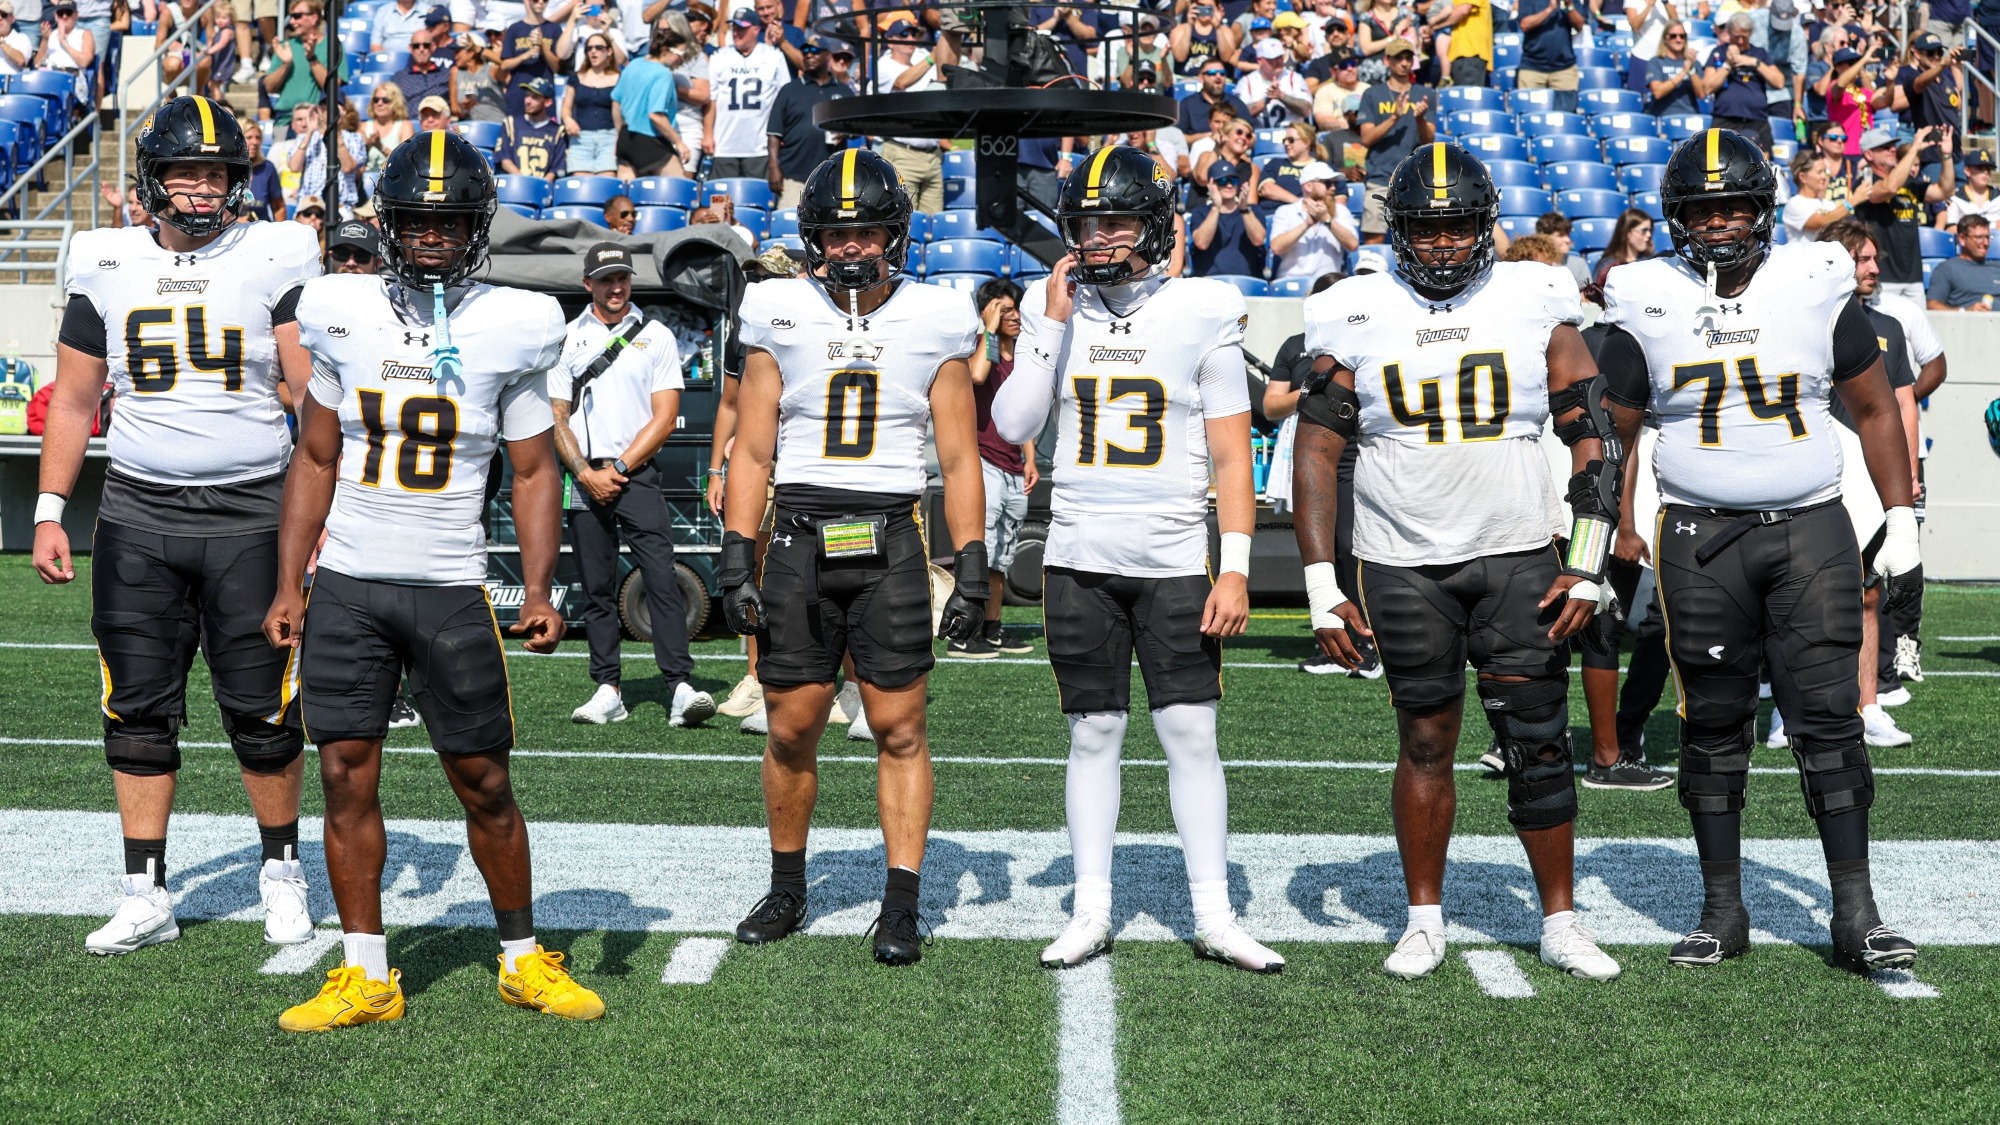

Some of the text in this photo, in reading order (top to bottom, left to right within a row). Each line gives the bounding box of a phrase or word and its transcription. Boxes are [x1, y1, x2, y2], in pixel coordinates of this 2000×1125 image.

[731, 67, 759, 75] NAVY
[729, 78, 762, 110] 12
[980, 136, 1017, 156] 562
[517, 146, 549, 176] 12
[98, 260, 117, 268] CAA
[597, 250, 624, 263] TOWSON
[156, 278, 209, 295] TOWSON
[1348, 315, 1366, 323] CAA
[1645, 307, 1662, 315] CAA
[327, 326, 346, 334] CAA
[771, 319, 791, 327] CAA
[1416, 327, 1470, 347] TOWSON
[1706, 328, 1760, 348] TOWSON
[125, 306, 244, 394] 64
[1089, 345, 1146, 365] TOWSON
[1382, 350, 1511, 445] 40
[1672, 355, 1810, 447] 74
[822, 370, 880, 460] 0
[1071, 376, 1168, 468] 13
[357, 388, 460, 493] 18
